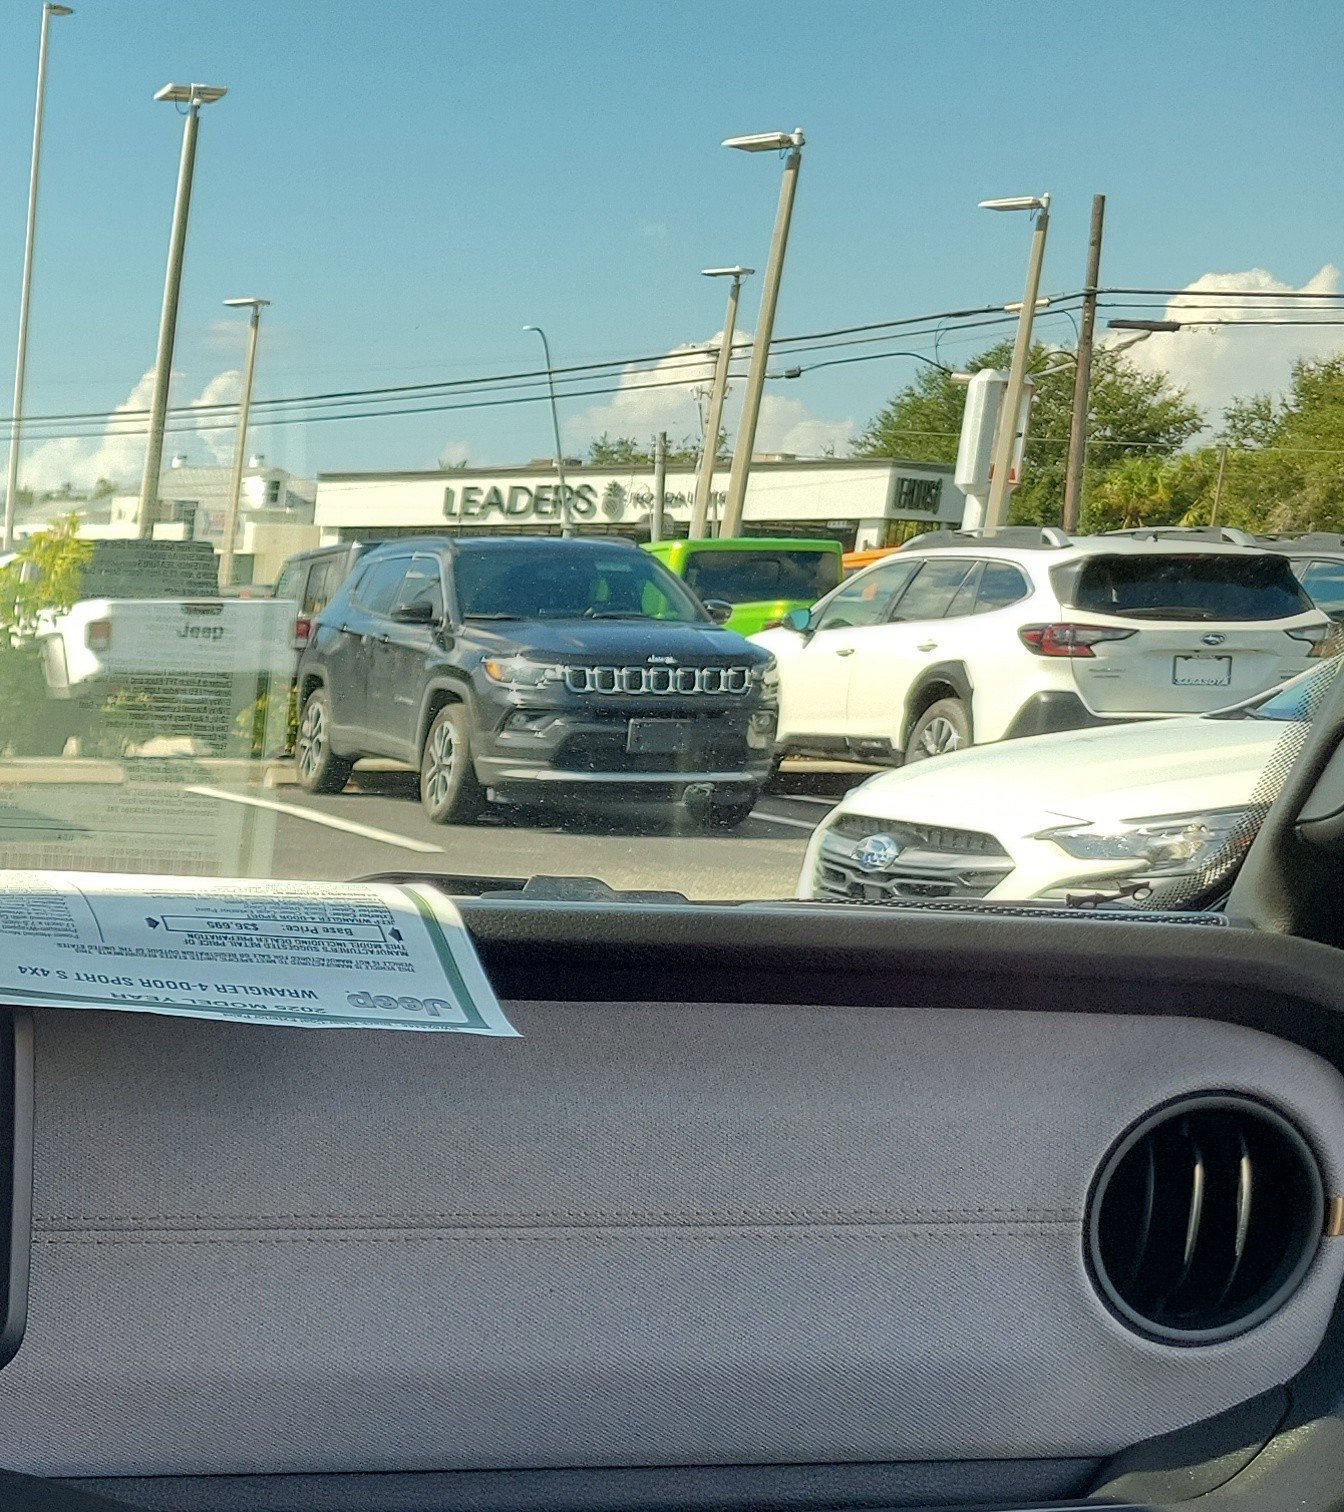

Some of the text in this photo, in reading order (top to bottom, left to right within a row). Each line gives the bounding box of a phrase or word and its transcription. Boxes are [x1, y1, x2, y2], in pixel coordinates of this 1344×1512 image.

[444, 484, 597, 520] LEADERS
[317, 927, 354, 937] Base
[16, 964, 318, 1001] WRANGLER 4-DOOR SPORT 4X4
[181, 998, 269, 1011] MODEL
[344, 990, 452, 1017] Jeep
